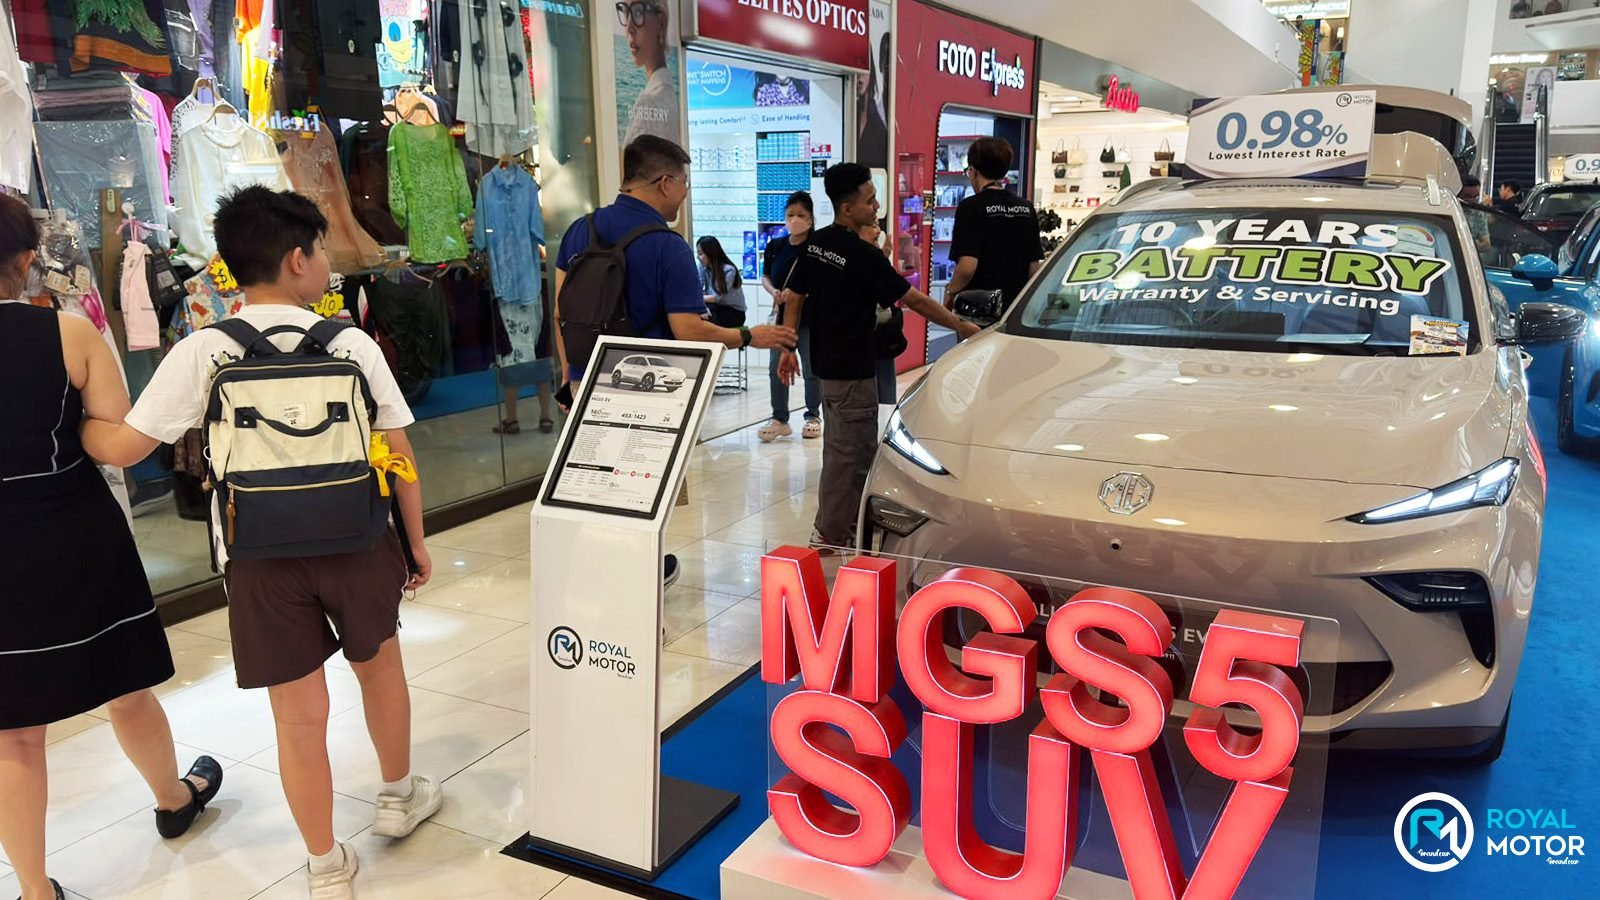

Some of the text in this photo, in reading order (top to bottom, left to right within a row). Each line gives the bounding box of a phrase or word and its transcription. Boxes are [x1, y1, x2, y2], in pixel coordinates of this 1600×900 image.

[738, 0, 866, 36] TES OPTICS
[939, 40, 1025, 96] FOTO Express
[628, 104, 669, 122] BURBERRY
[777, 114, 784, 122] of
[785, 113, 811, 121] Handling
[1217, 109, 1348, 151] 0.98%
[1209, 148, 1347, 160] Lowest Interest Rate
[986, 205, 1030, 213] ROYAL MOTOR
[1117, 219, 1400, 248] 10 YEARS
[823, 249, 847, 267] MOTOR
[1063, 245, 1451, 295] BATTERY
[1079, 286, 1401, 316] Warranty & Servicing
[1183, 628, 1207, 644] EV
[589, 640, 632, 659] ROYAL
[589, 656, 636, 675] MOTOR
[761, 545, 1305, 782] MGS5
[767, 690, 1294, 900] SUV
